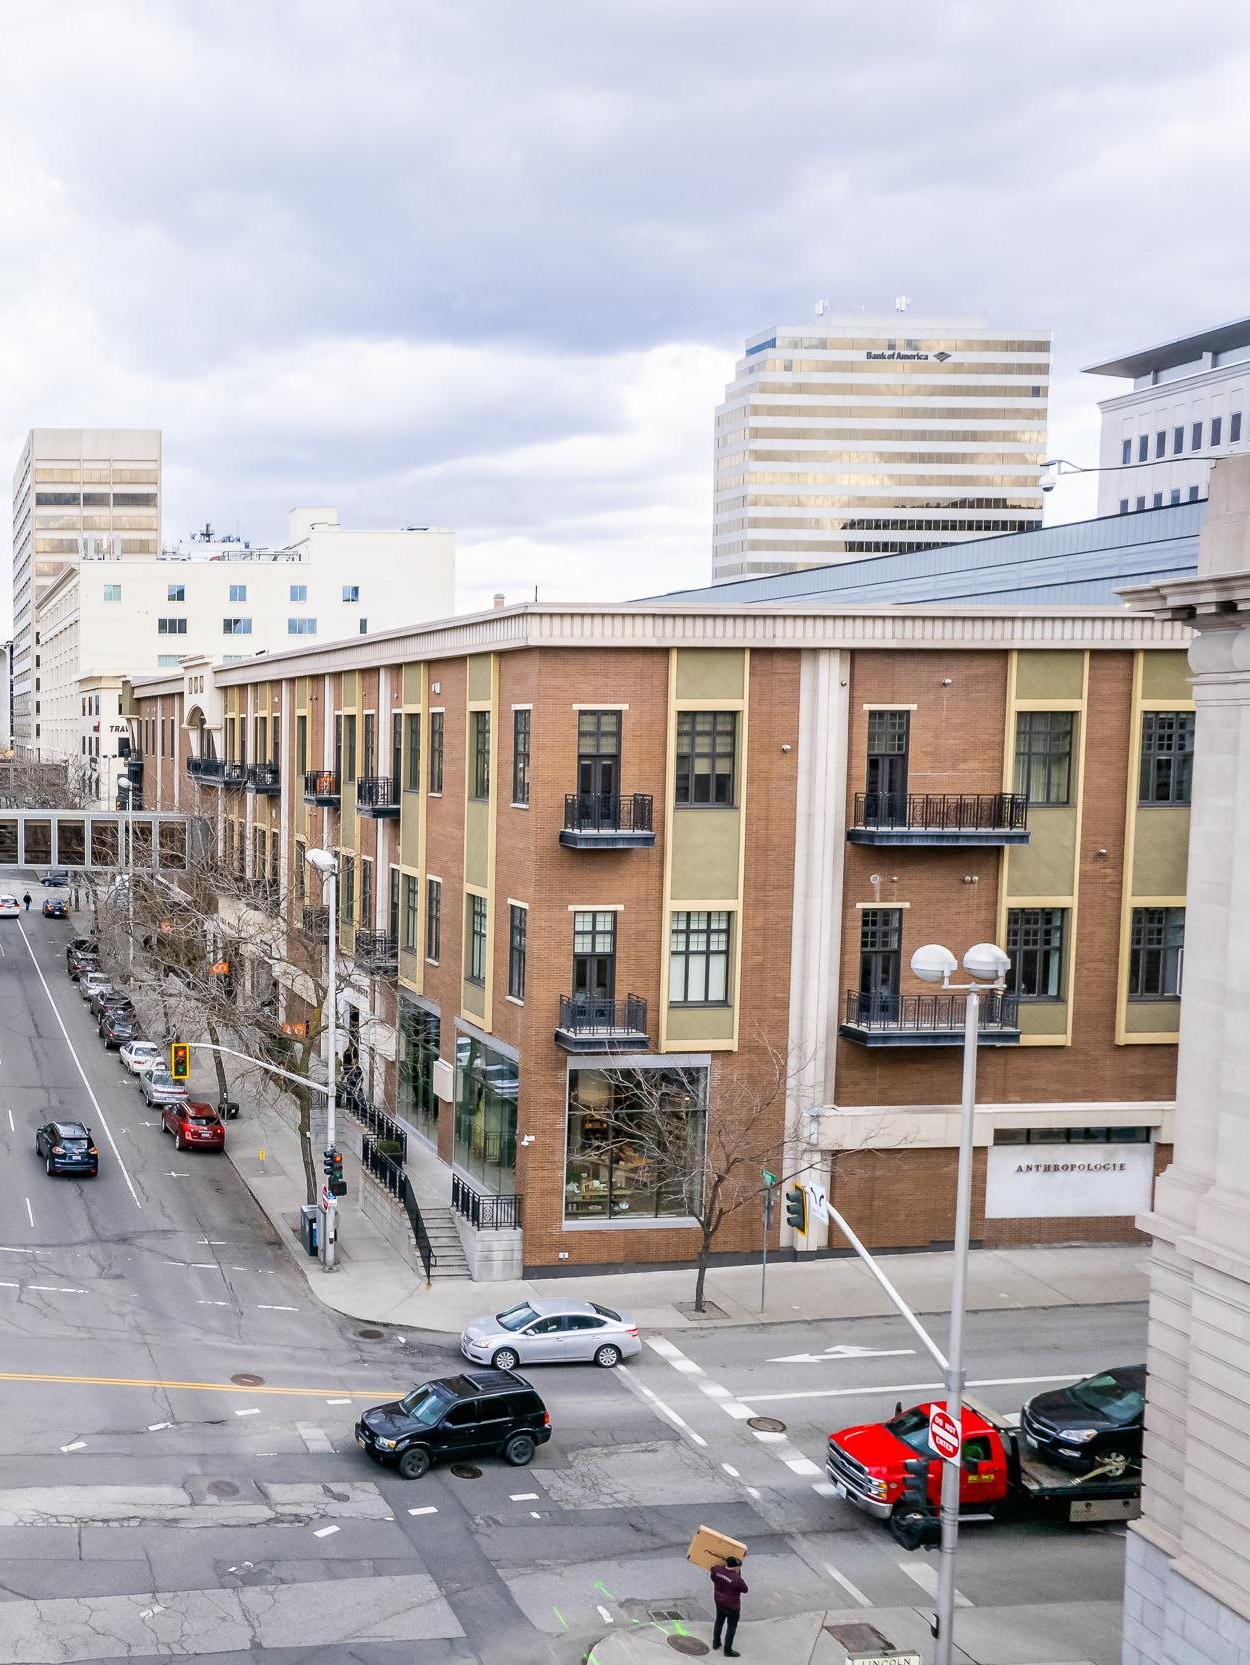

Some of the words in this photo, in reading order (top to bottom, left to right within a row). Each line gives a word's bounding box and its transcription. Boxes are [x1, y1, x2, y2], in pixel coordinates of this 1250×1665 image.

[866, 352, 886, 360] Bank
[887, 352, 895, 360] of
[896, 352, 928, 361] America
[1016, 1162, 1126, 1173] ANTHROPOLOGIE
[935, 1416, 943, 1426] DO
[945, 1423, 956, 1434] NOT
[936, 1436, 953, 1453] ENTER
